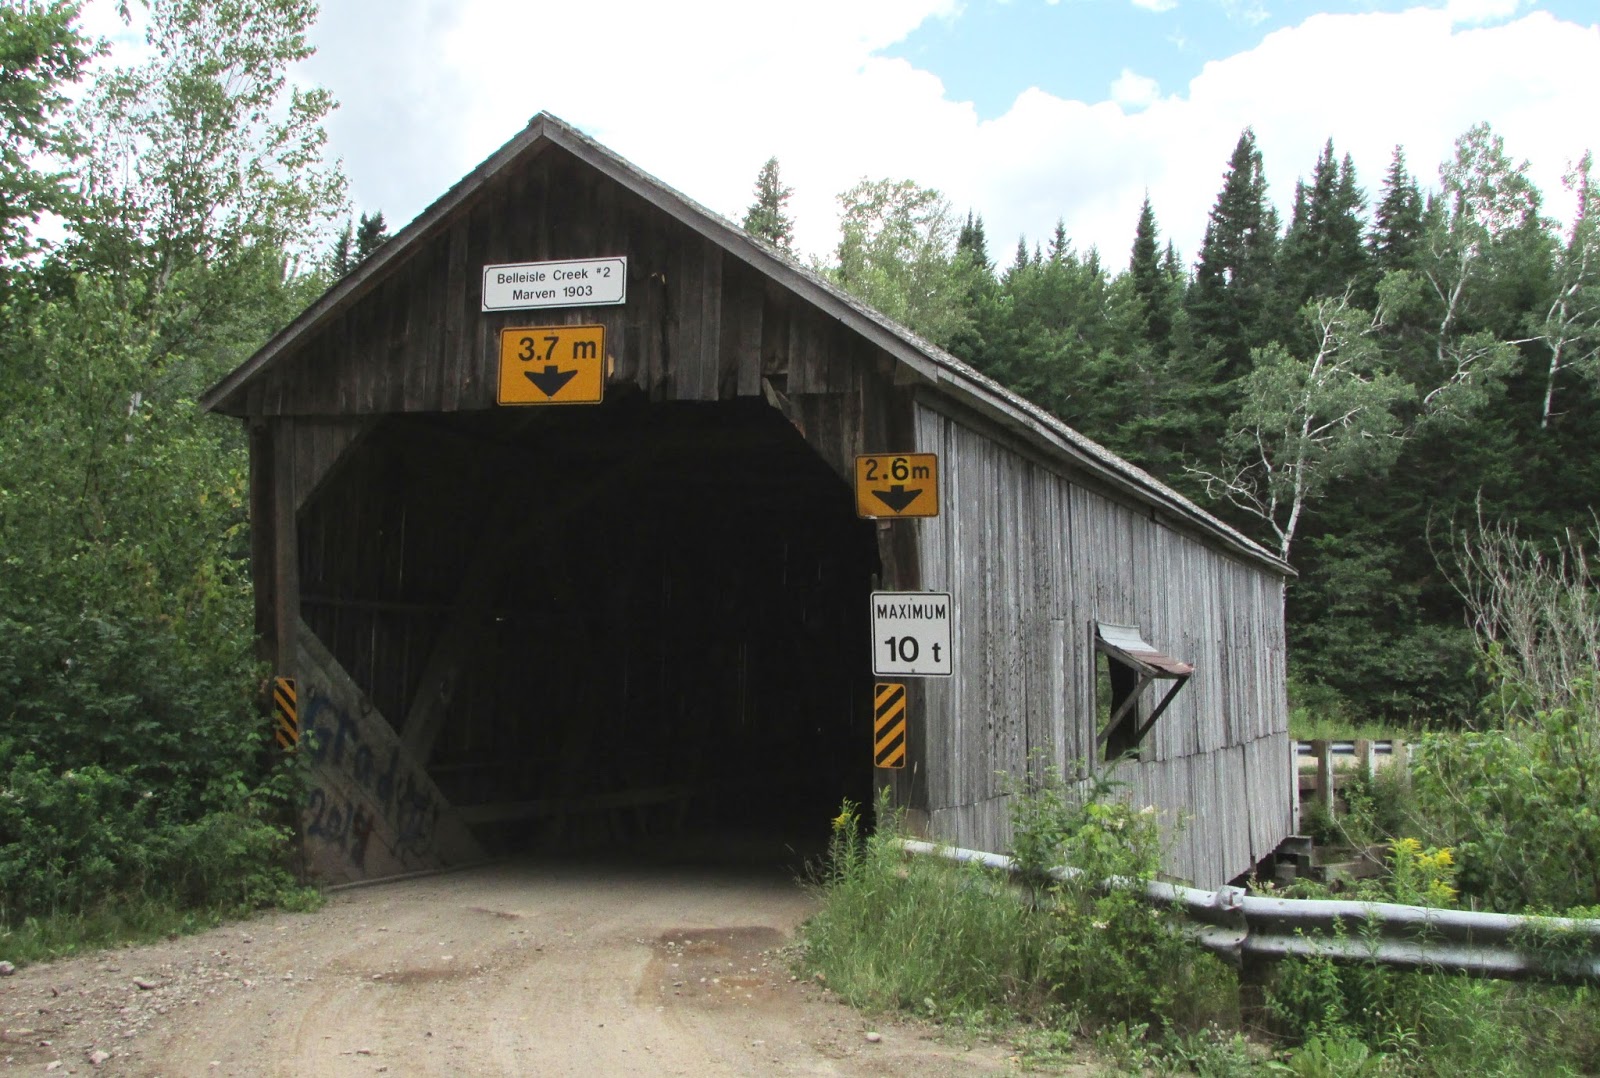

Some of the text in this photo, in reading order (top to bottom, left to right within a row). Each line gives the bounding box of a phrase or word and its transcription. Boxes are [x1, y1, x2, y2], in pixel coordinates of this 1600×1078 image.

[497, 271, 546, 284] Belleisle
[553, 268, 588, 281] Creek
[512, 285, 593, 300] Marven 1903
[518, 336, 596, 361] 3.7 m
[877, 604, 946, 620] MAXIMUM
[884, 636, 941, 663] 10 t
